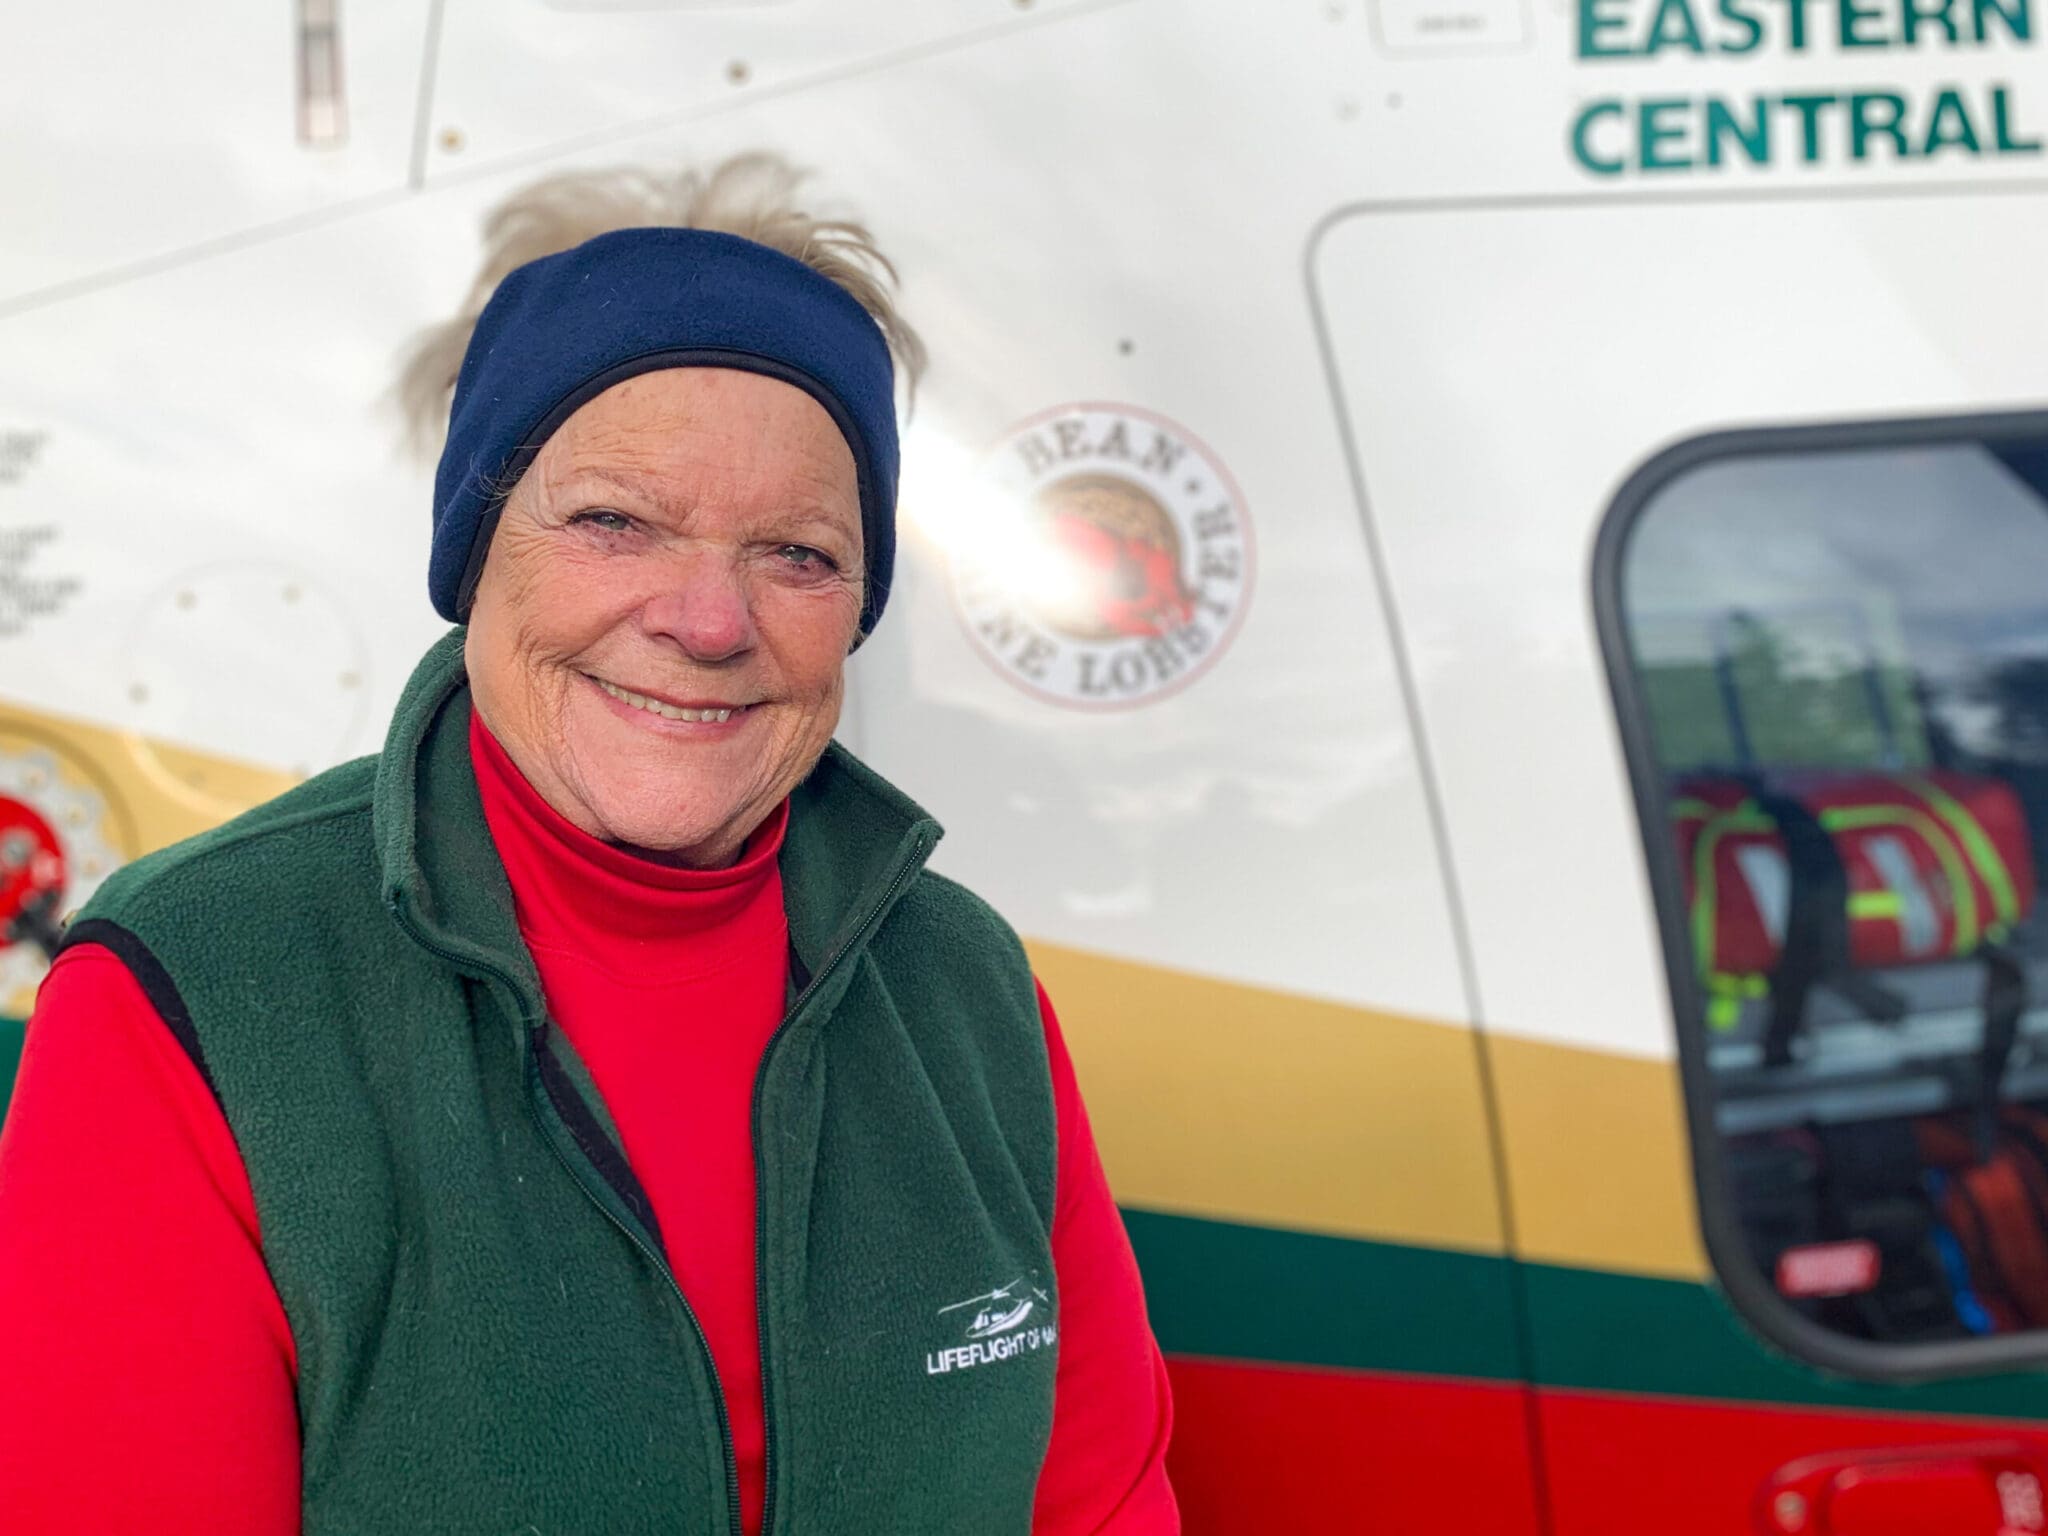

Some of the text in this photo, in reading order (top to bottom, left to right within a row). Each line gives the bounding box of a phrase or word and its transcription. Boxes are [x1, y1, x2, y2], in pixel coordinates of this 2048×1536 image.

[1577, 0, 2034, 58] EASTERN
[1569, 87, 2042, 174] CENTRAL
[1014, 419, 1187, 475] BEAN
[927, 1334, 1026, 1374] LIFEFLIGHT
